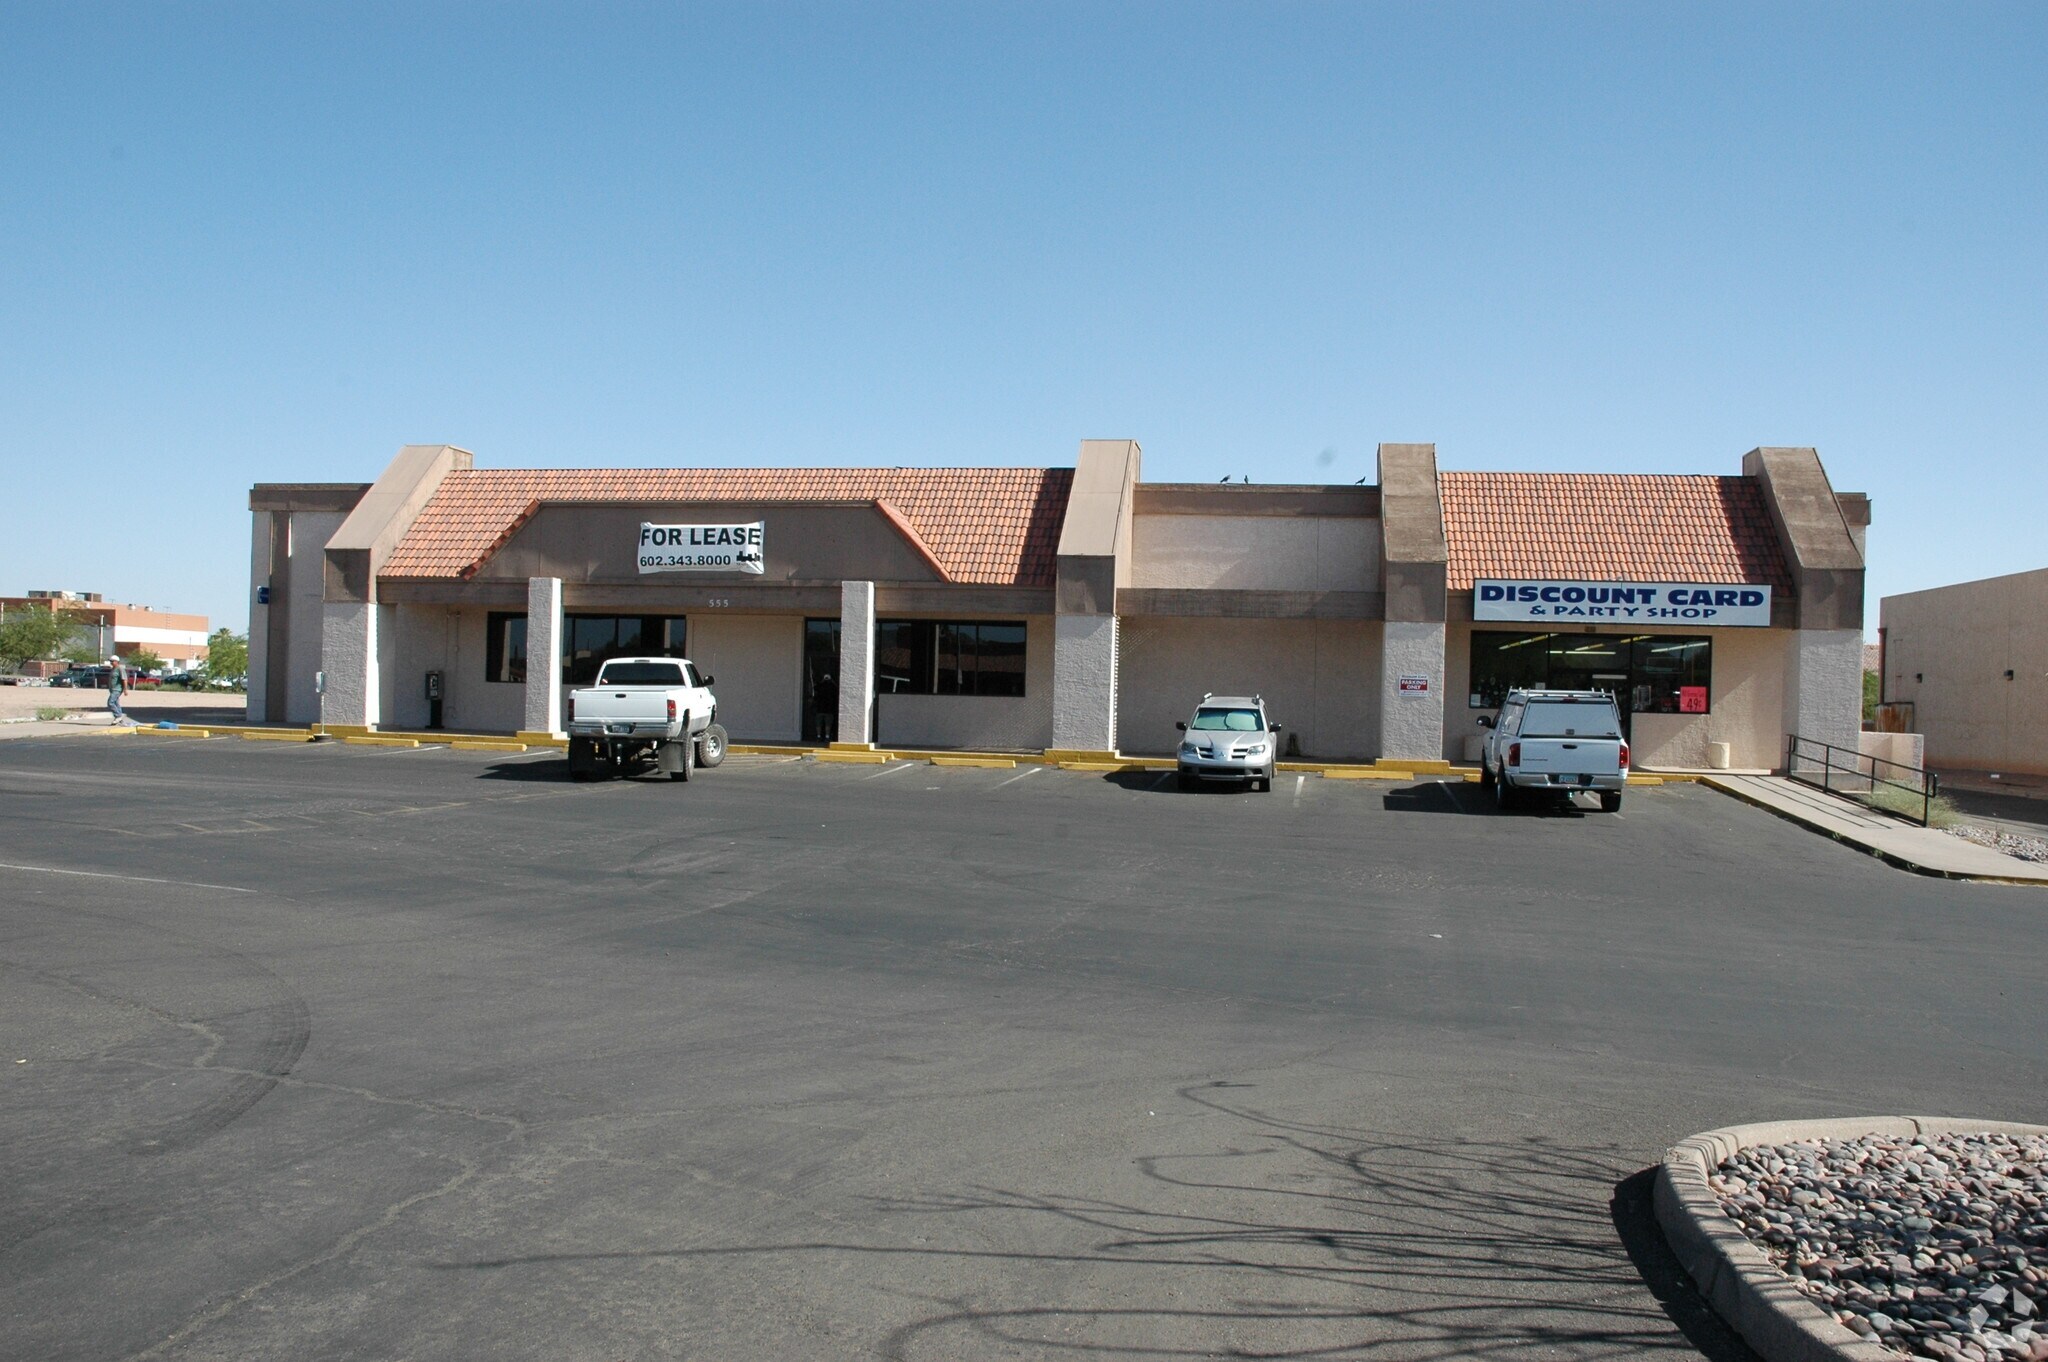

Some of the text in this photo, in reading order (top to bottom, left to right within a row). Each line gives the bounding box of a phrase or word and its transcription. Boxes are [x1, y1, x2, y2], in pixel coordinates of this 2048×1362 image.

[641, 528, 762, 546] FOR LEASE
[640, 555, 731, 567] 602.343.8000
[1481, 585, 1764, 607] DISCOUNT CARD
[708, 599, 729, 608] 555
[1529, 605, 1717, 618] & PARTY SHOP
